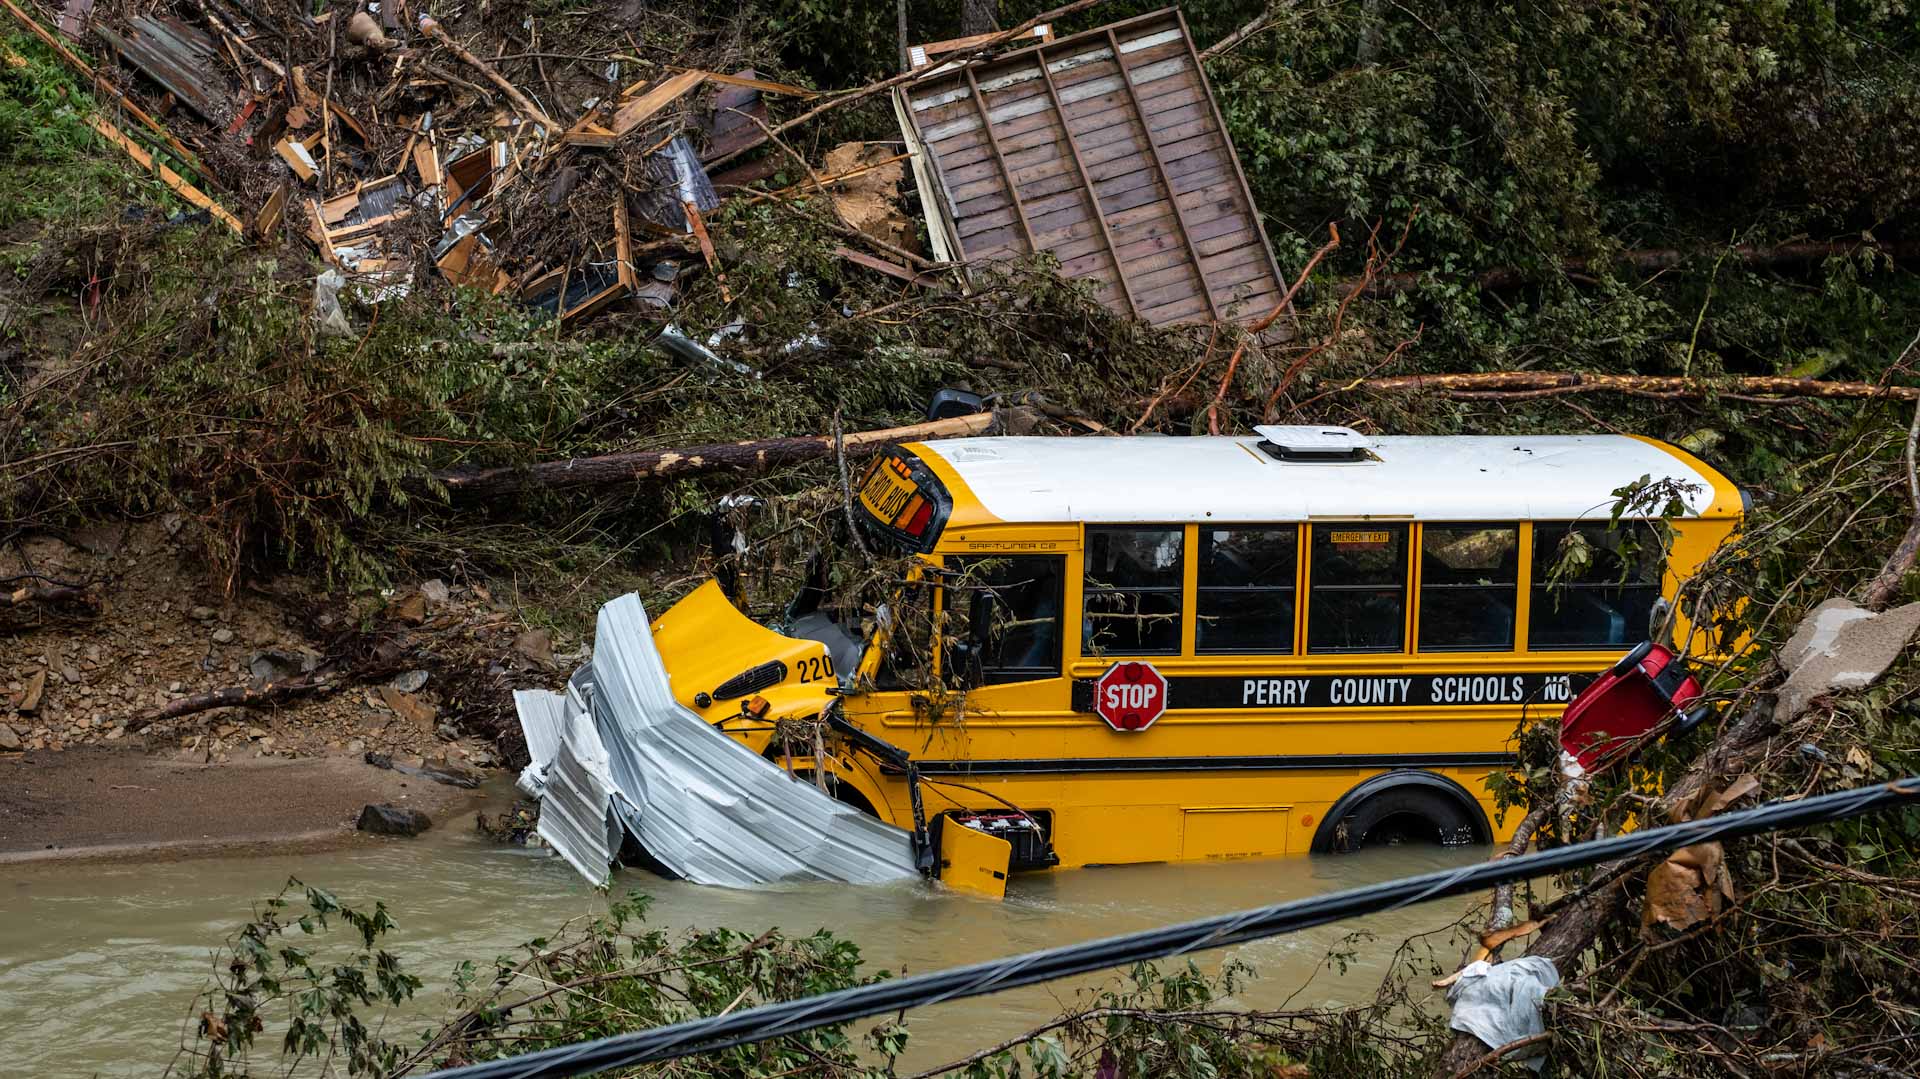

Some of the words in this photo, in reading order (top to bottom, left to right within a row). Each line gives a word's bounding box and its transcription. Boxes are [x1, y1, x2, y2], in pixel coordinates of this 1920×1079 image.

[879, 485, 910, 519] BUS
[1040, 542, 1057, 550] C2
[1332, 533, 1372, 542] EMERGENY
[1374, 532, 1388, 541] EXIT
[797, 654, 835, 684] 220
[1106, 683, 1157, 709] STOP
[1243, 679, 1310, 705] PERRY
[1330, 678, 1412, 704] COUNTY
[1431, 676, 1524, 702] SCHOOLS
